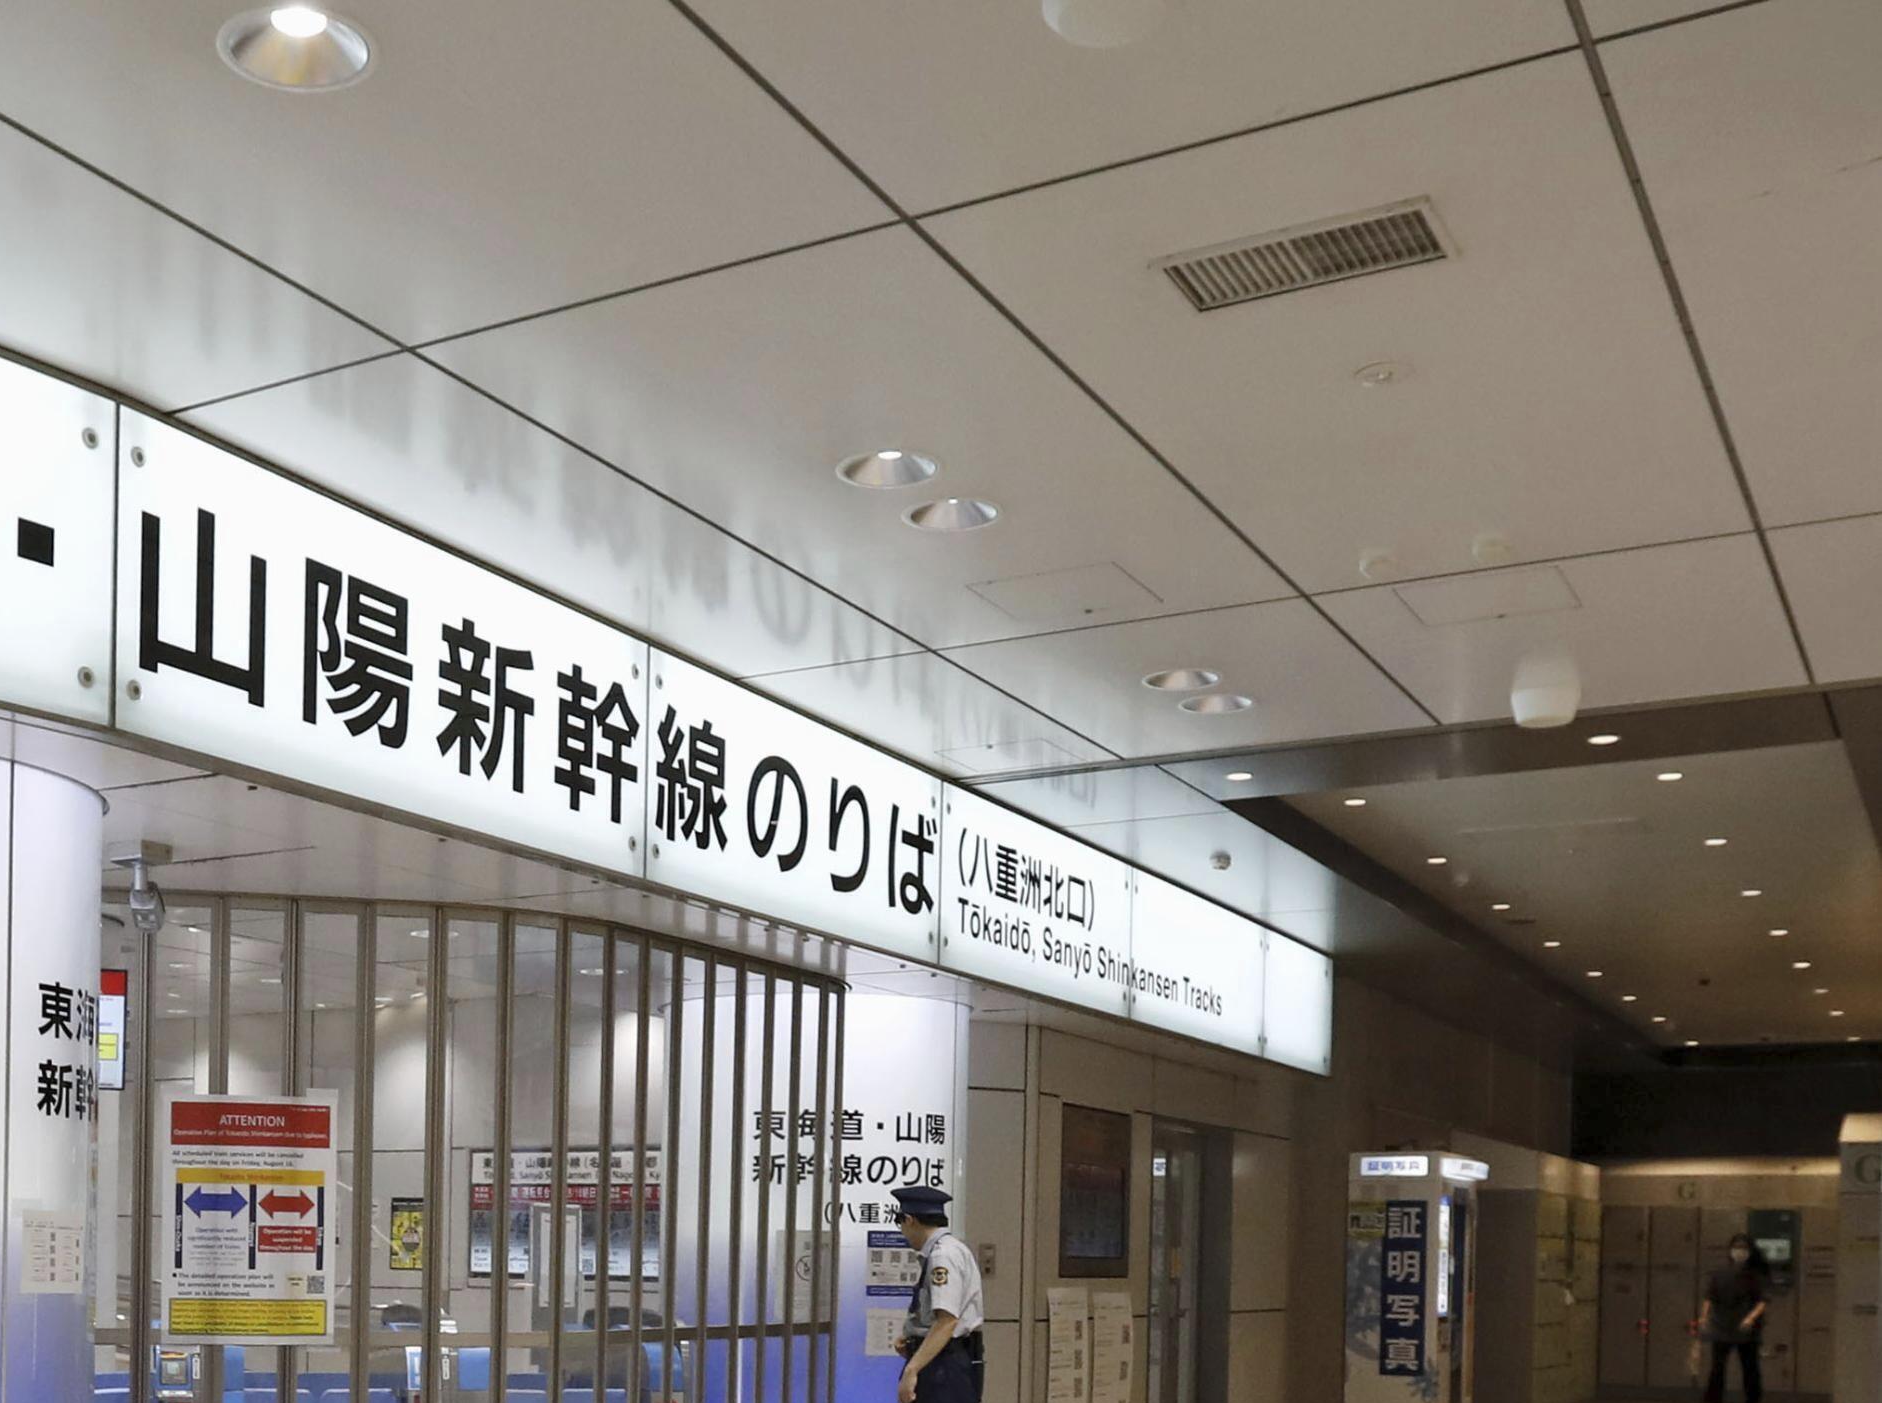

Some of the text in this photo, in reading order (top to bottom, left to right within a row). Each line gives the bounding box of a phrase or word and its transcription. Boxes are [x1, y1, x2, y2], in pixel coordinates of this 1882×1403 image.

[957, 827, 1096, 932] (八重洲北口)
[957, 897, 1223, 1017] Tōkaidō, Sanyō Shinkansen Tracks
[219, 1114, 286, 1128] ATTENTION
[1385, 1206, 1422, 1371] 証明写真
